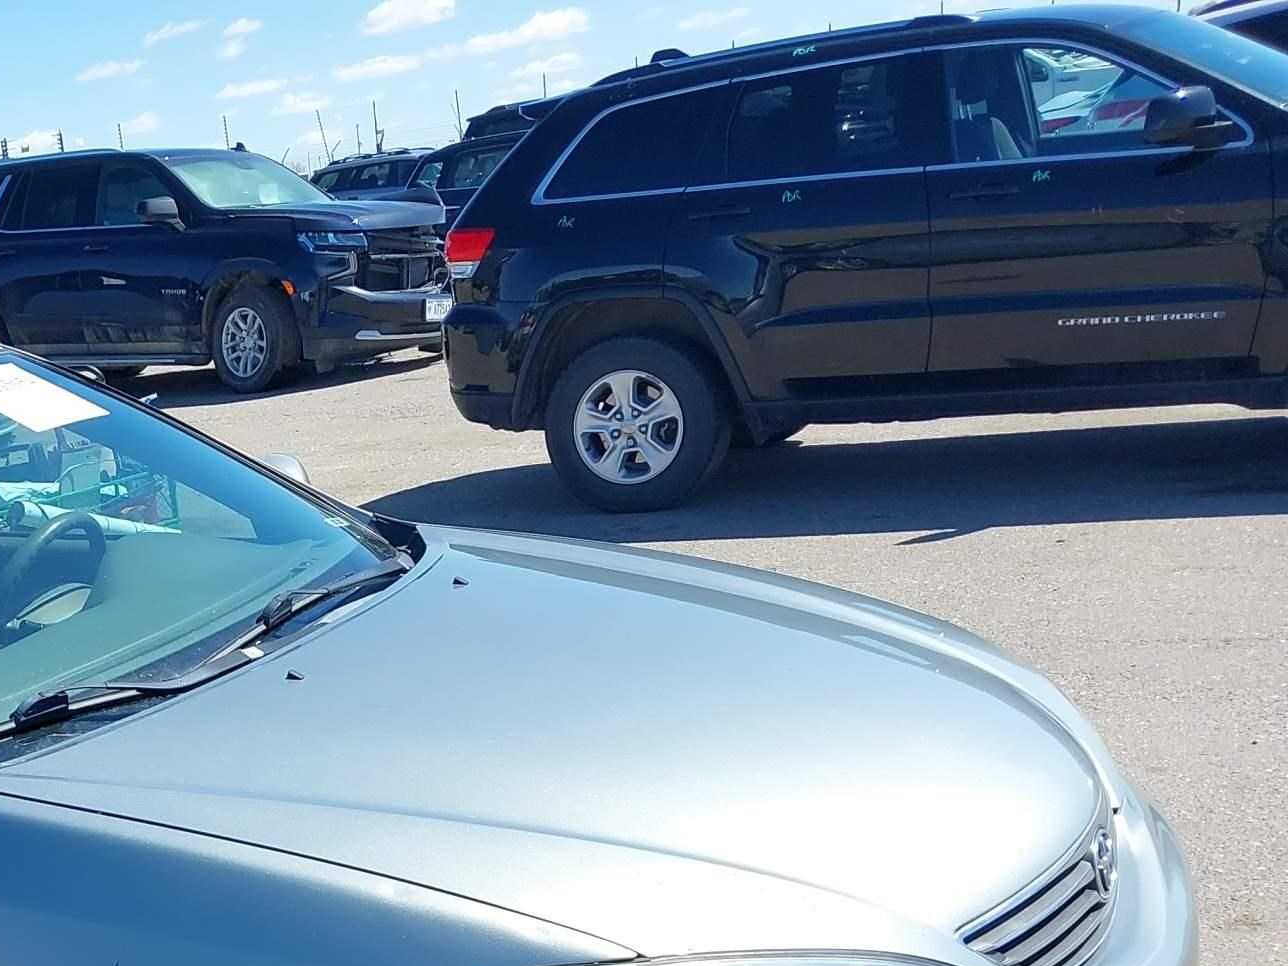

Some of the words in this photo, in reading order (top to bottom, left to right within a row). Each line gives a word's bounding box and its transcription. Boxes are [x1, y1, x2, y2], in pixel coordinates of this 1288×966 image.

[160, 289, 187, 297] TAHOE
[1057, 316, 1120, 326] GRAND
[1124, 311, 1227, 324] CHEROKEE
